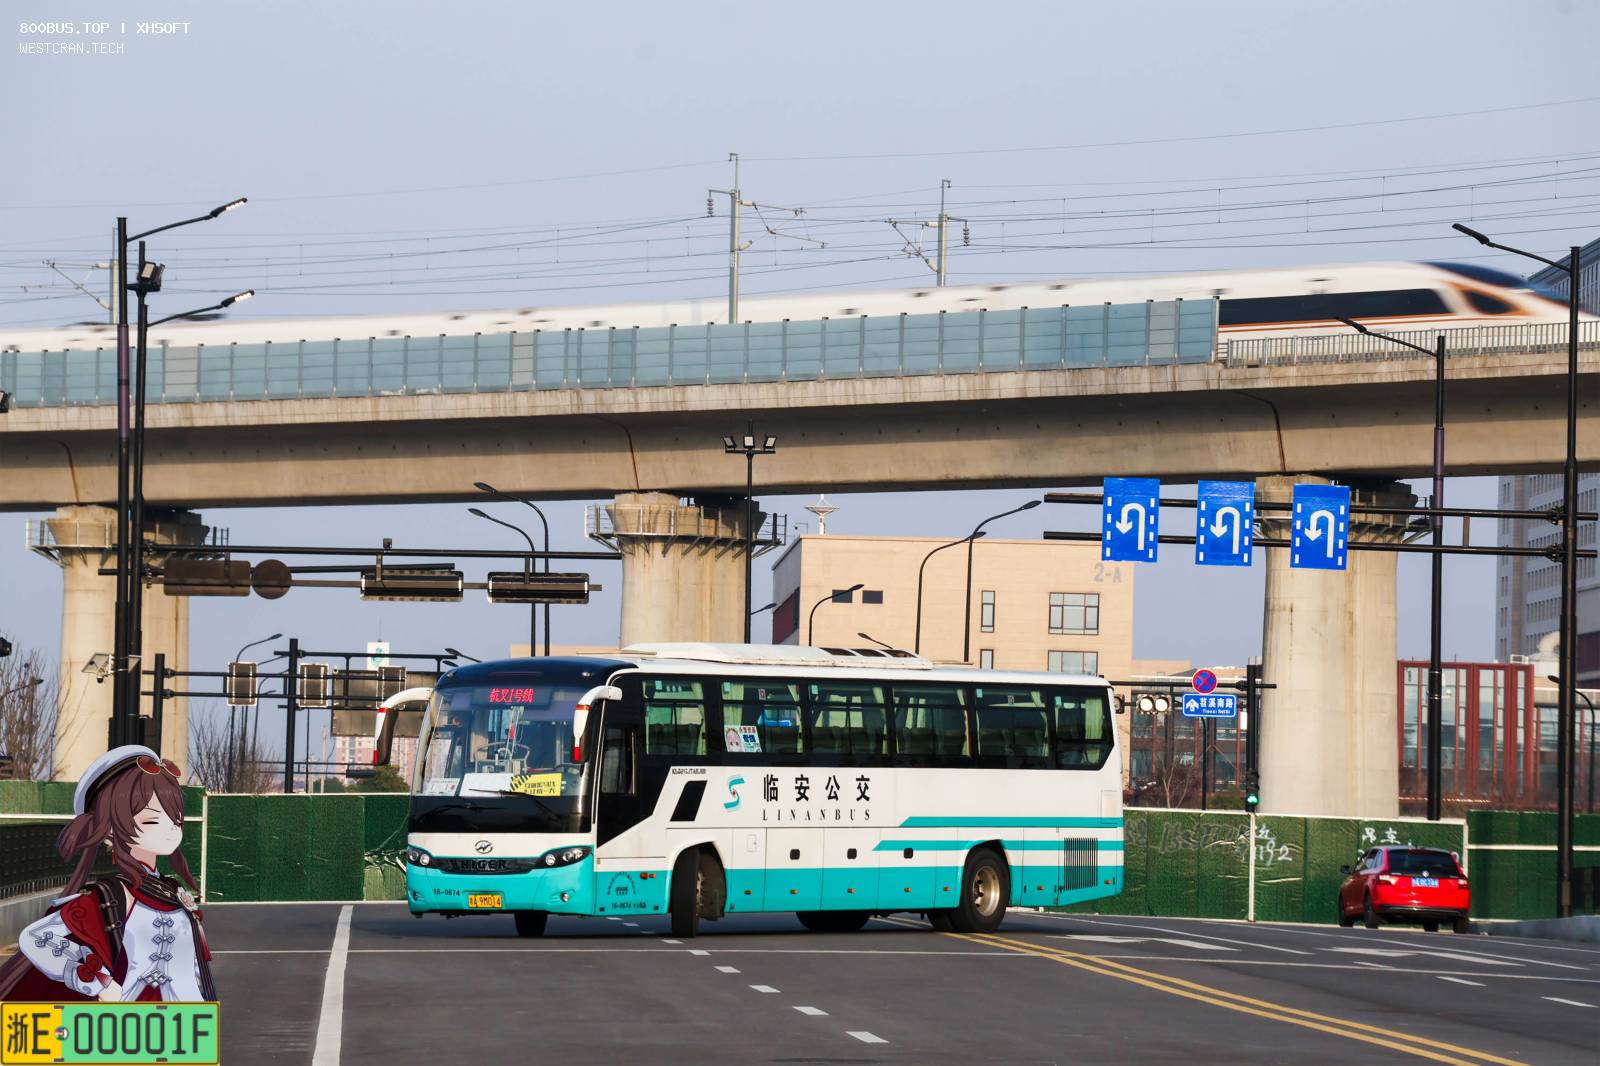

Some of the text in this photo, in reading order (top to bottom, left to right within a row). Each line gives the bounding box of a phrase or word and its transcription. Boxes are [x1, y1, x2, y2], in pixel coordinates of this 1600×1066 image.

[1094, 562, 1122, 583] 2-A
[1200, 697, 1233, 708] 苕溪南路
[763, 774, 870, 802] 临安公交
[763, 809, 870, 821] LINANBUS
[461, 860, 507, 870] HIGER
